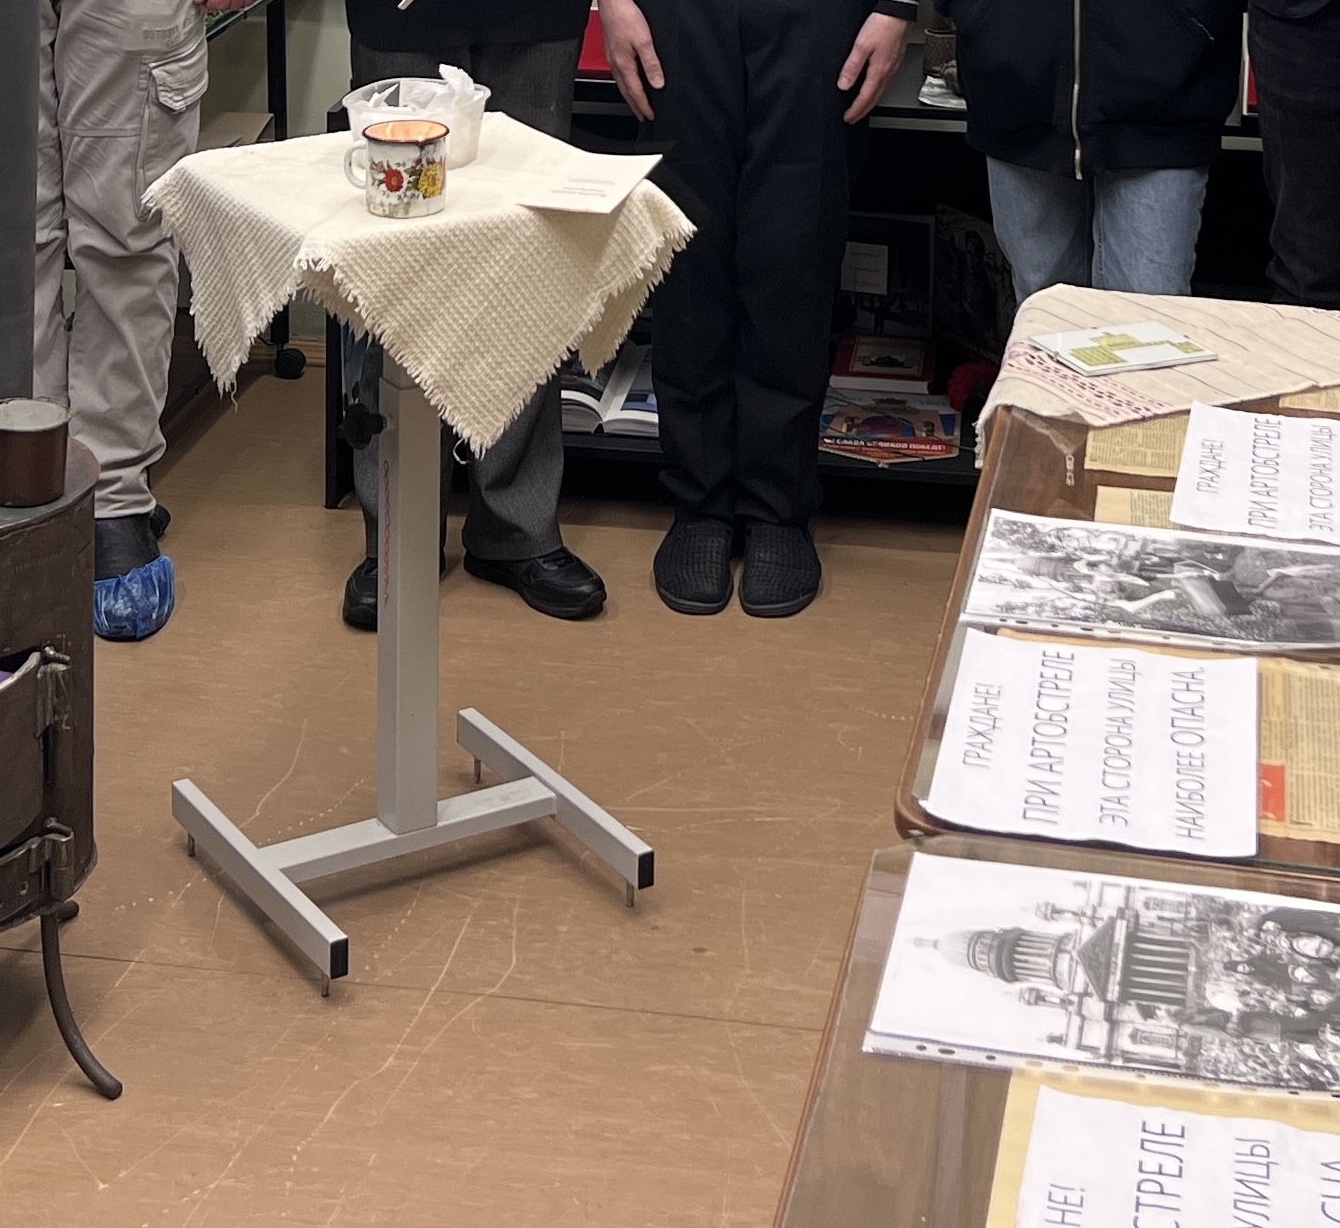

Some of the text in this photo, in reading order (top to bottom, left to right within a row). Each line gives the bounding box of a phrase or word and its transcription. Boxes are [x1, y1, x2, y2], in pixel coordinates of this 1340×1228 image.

[1196, 438, 1227, 494] ГРАЖДАНЕ!
[1247, 417, 1282, 530] ПРИ АРТОБСТРЕЛЕ
[1309, 424, 1337, 532] ЭТА СТОРОНА УЛИЦЫ
[962, 682, 1004, 770] ГРАЖДАНЕ!
[1022, 650, 1075, 825] ПРИ АРТОБСТРЕЛЕ
[1099, 658, 1140, 828] ЭТА СТОРОНА УЛИЦЫ
[1175, 750, 1206, 841] НАИБОЛЕЕ
